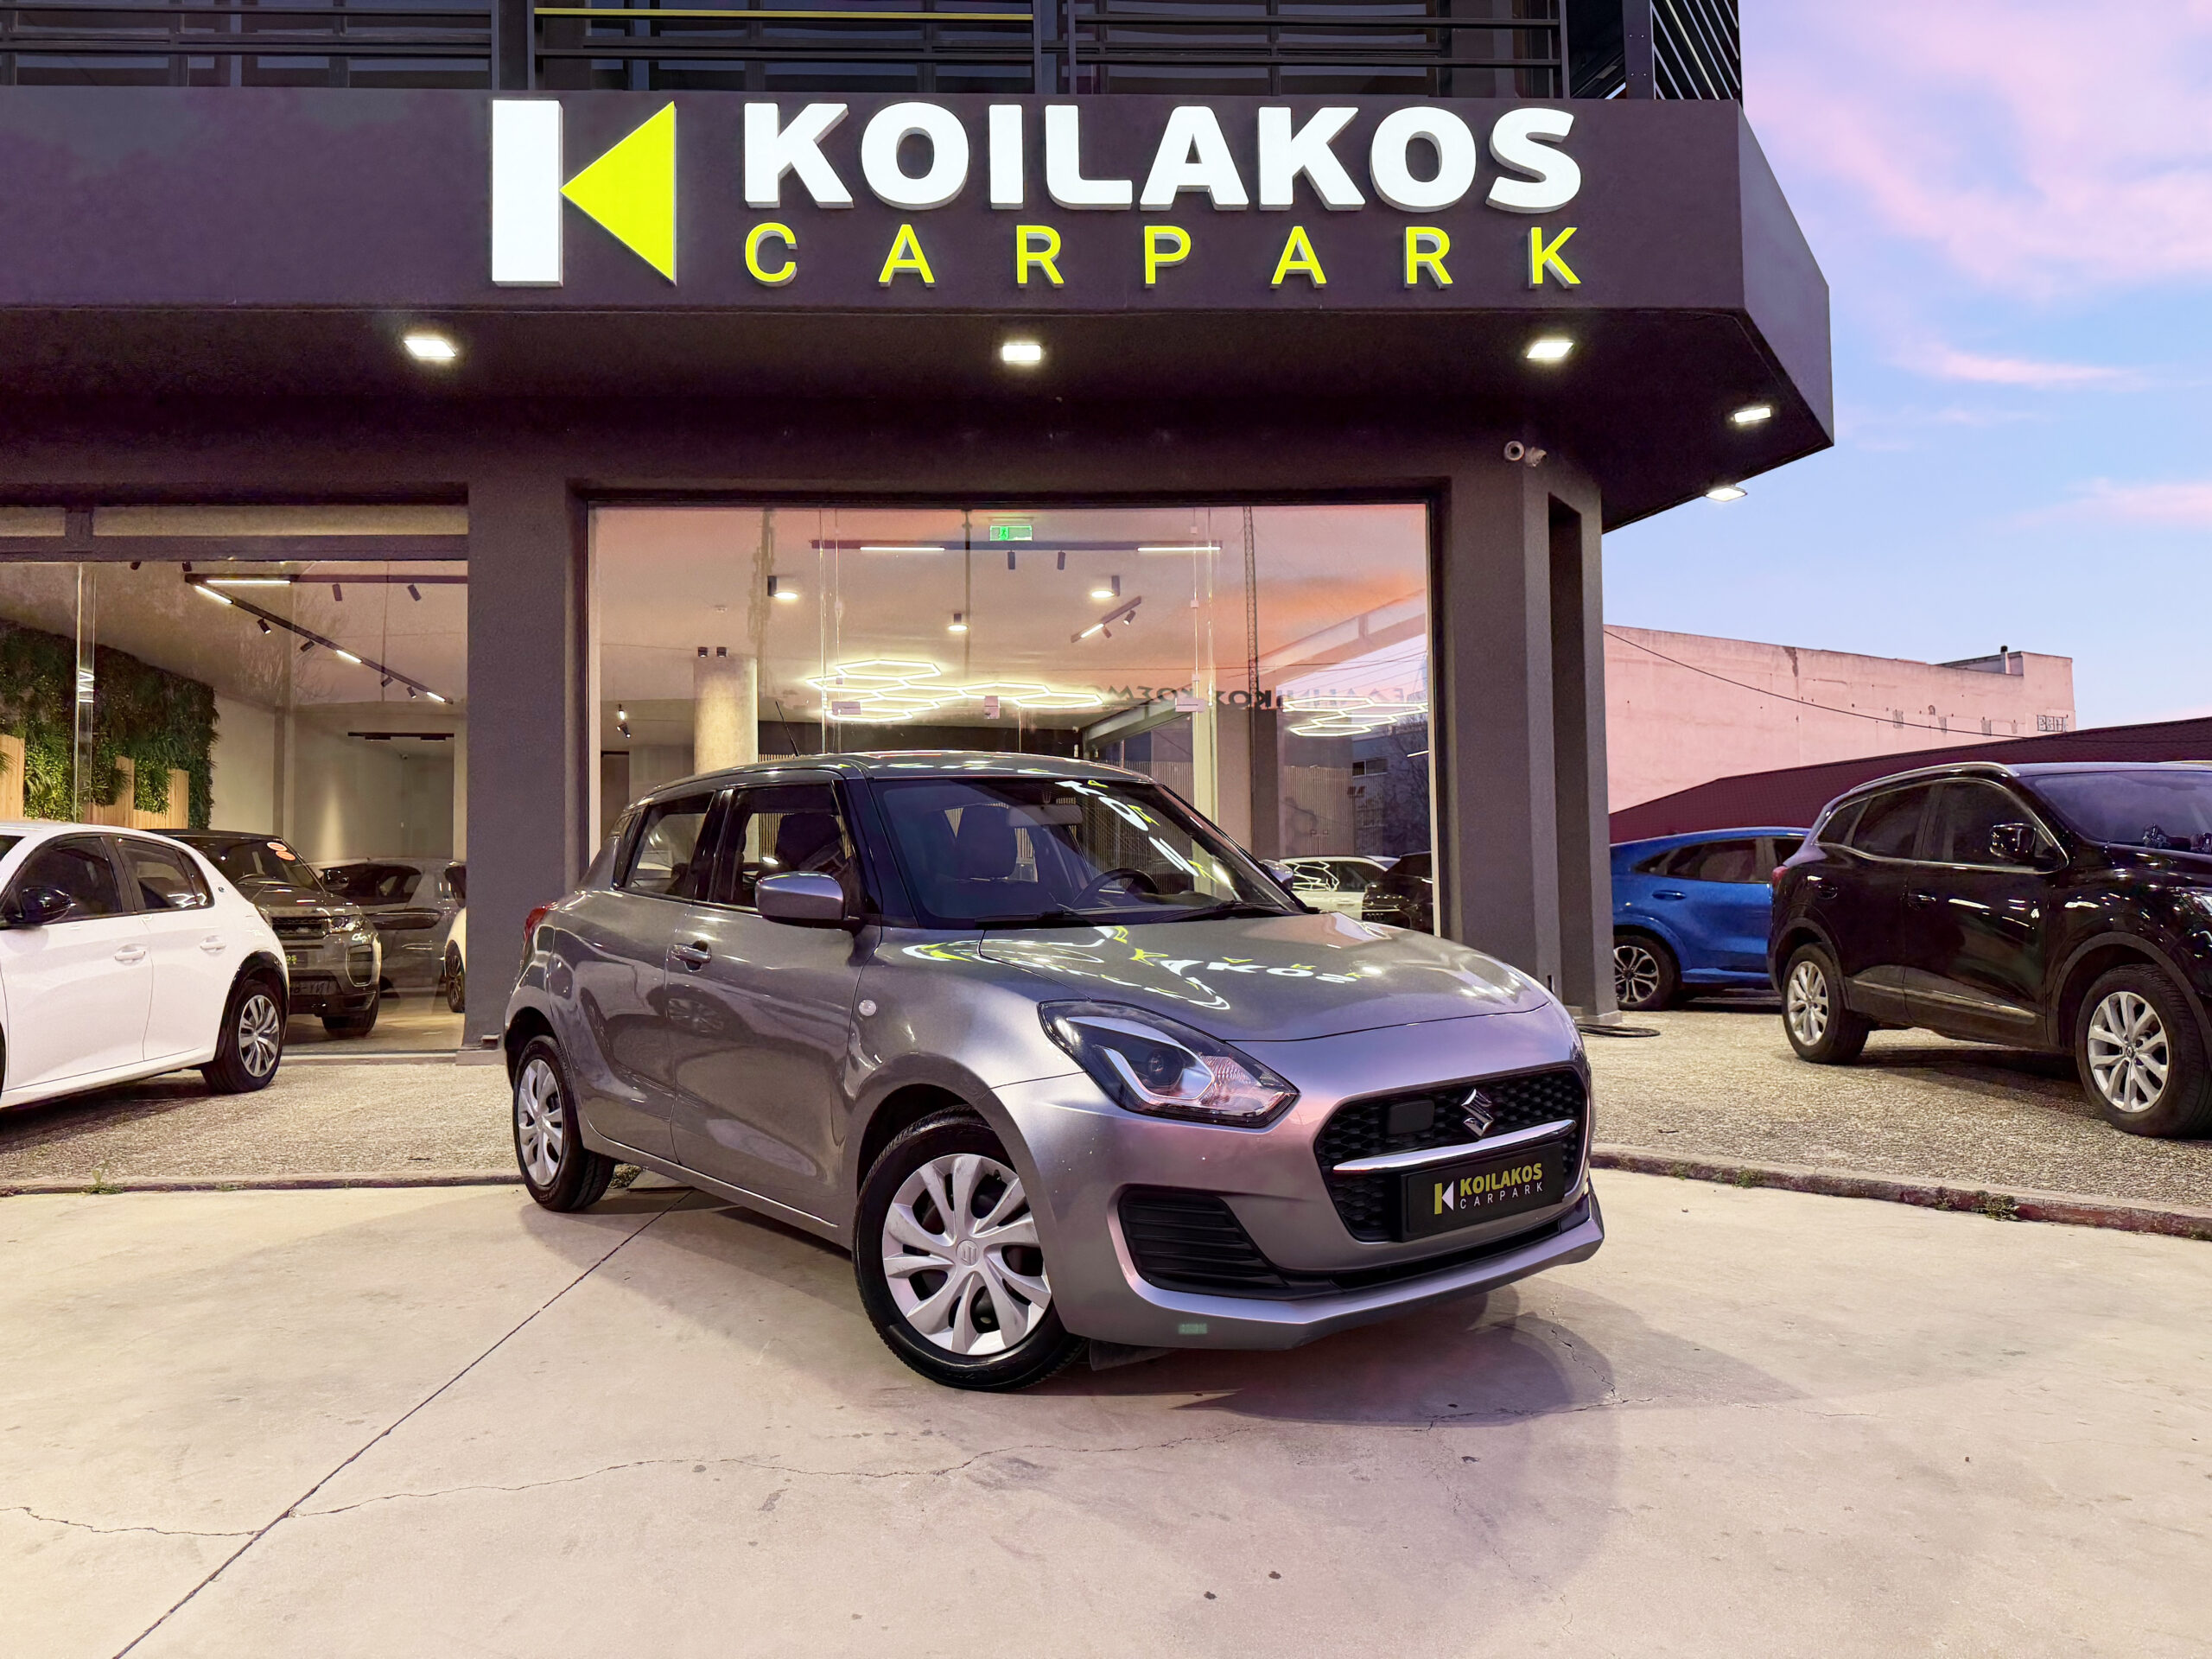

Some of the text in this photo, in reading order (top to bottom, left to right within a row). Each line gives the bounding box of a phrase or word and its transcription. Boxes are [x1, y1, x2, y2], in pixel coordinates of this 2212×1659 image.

[744, 102, 1581, 213] KOILAKOS
[744, 222, 1581, 288] CARPARK
[1459, 1162, 1543, 1198] KOILAKOS
[1459, 1181, 1543, 1210] CARPARK
